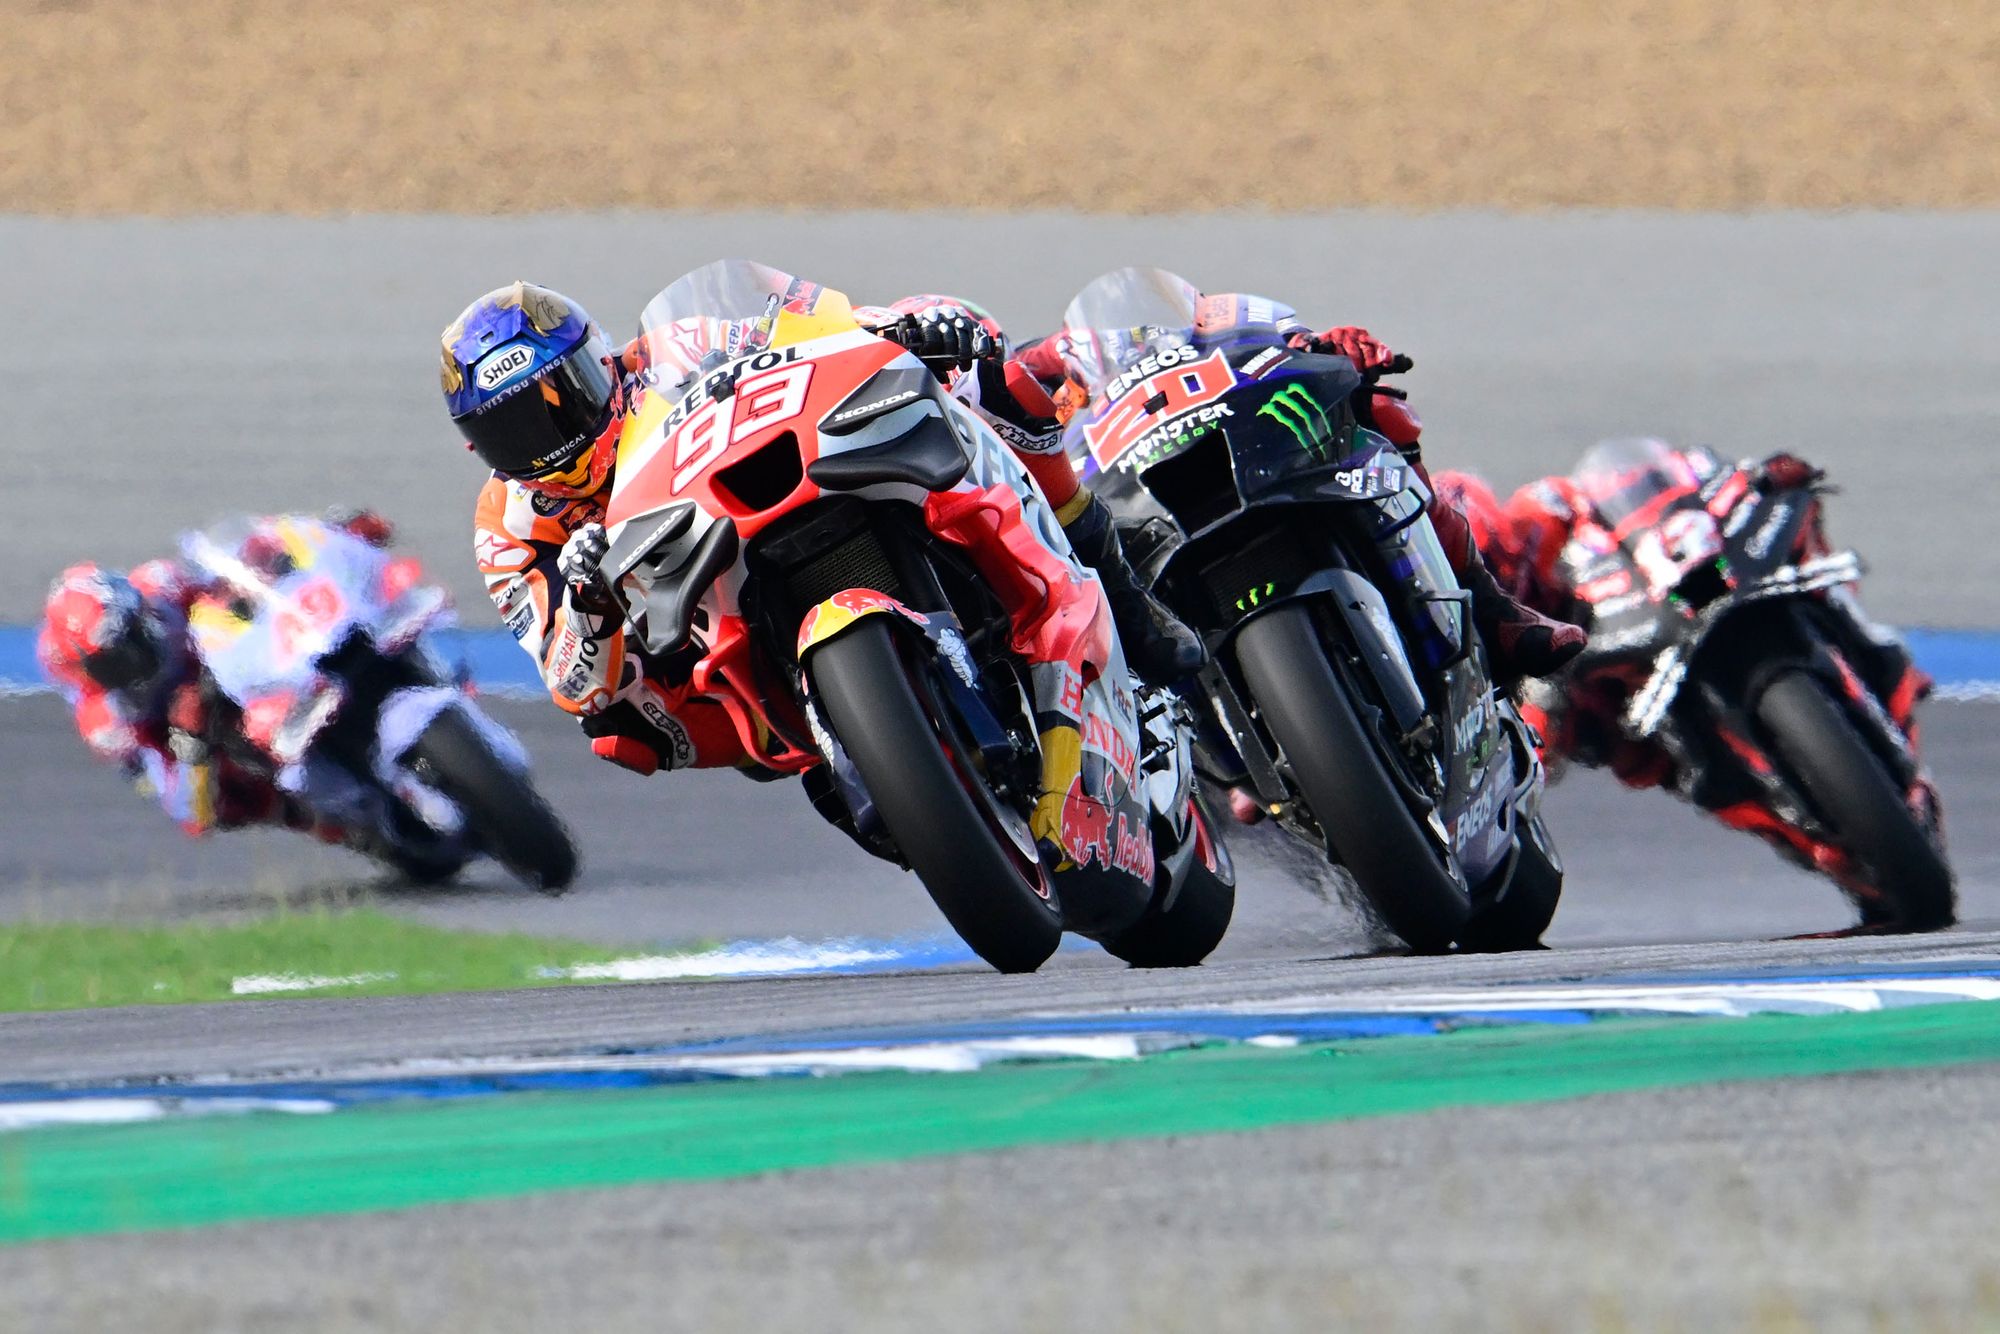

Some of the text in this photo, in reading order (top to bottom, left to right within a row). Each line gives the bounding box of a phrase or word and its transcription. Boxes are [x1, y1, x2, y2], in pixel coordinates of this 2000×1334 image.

[476, 355, 567, 416] GIVES YOU WINGS
[483, 350, 527, 384] SHOEI
[1106, 345, 1199, 401] ENEOS
[670, 361, 817, 496] 93
[834, 389, 919, 422] HONDA
[1083, 348, 1239, 474] 20
[543, 434, 587, 463] VERTICAL
[993, 423, 1060, 451] alpinestars
[1117, 402, 1235, 474] MONSTER
[618, 508, 684, 572] HONDA
[557, 638, 599, 698] REPSO
[1060, 671, 1136, 796] HNDA
